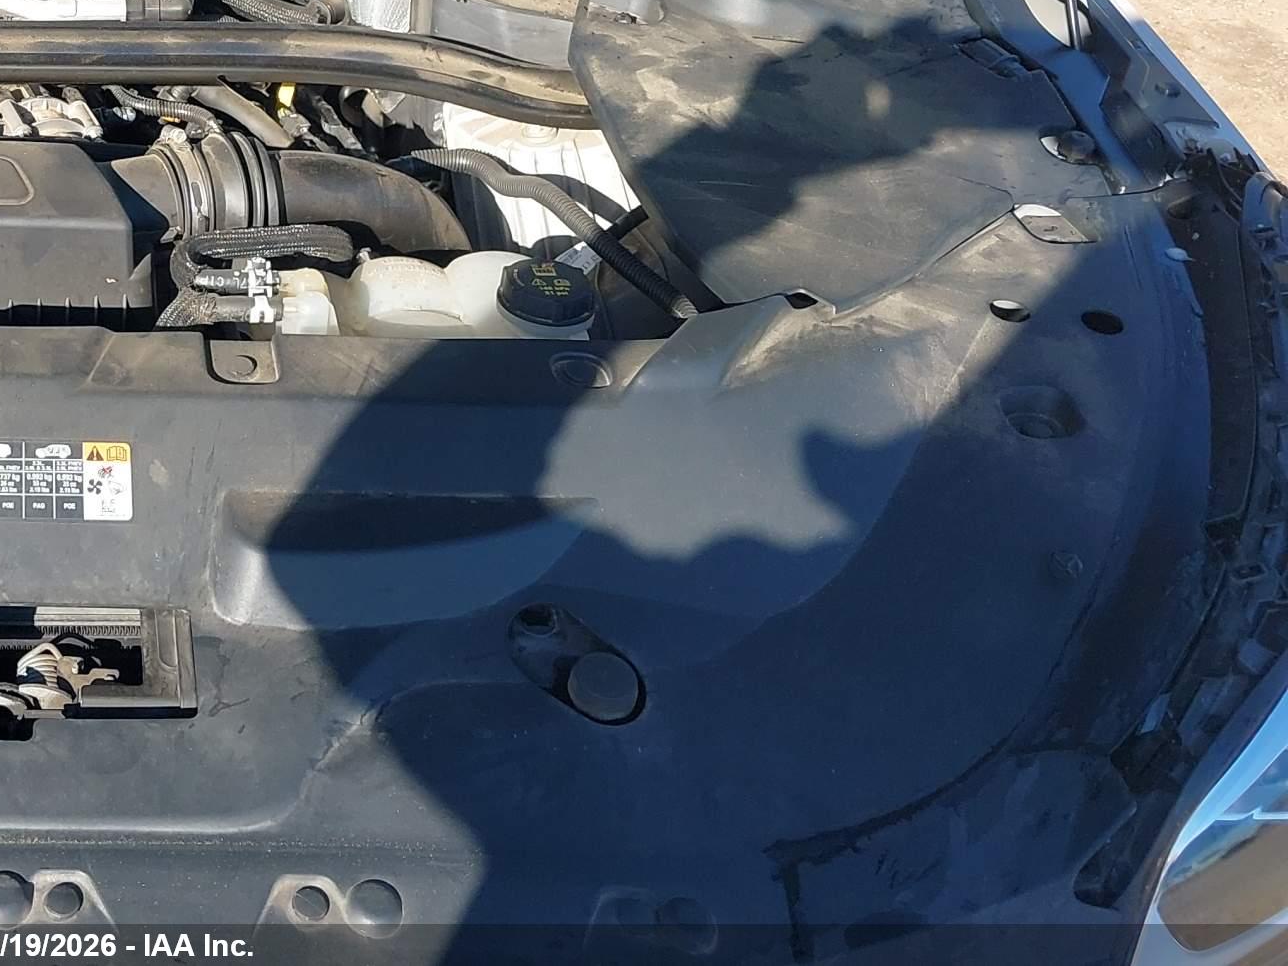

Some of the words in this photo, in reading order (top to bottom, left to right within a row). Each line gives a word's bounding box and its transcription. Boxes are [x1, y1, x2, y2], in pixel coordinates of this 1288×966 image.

[12, 474, 20, 482] kg
[44, 474, 52, 482] kg
[74, 474, 82, 483] kg
